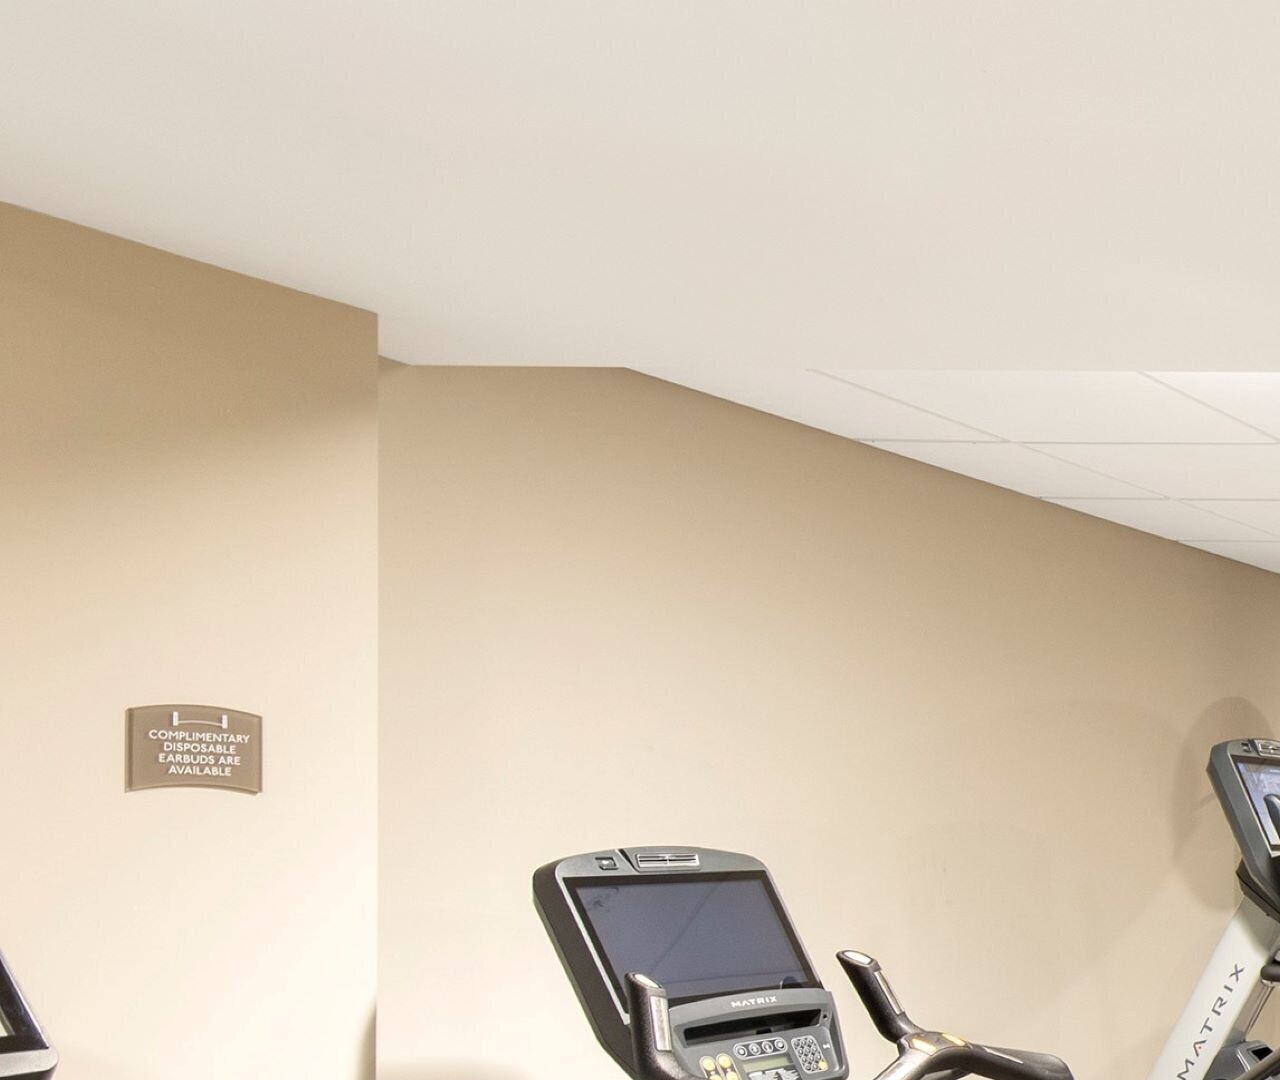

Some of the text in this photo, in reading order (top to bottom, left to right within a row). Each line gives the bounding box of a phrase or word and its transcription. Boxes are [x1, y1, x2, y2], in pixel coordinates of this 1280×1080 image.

[149, 729, 250, 743] COMPLIMENTARY
[163, 741, 236, 754] DISPOSABLE
[159, 753, 241, 765] EARBUDS ARE
[168, 765, 232, 776] AVAILABLE
[730, 996, 777, 1008] MATRIX
